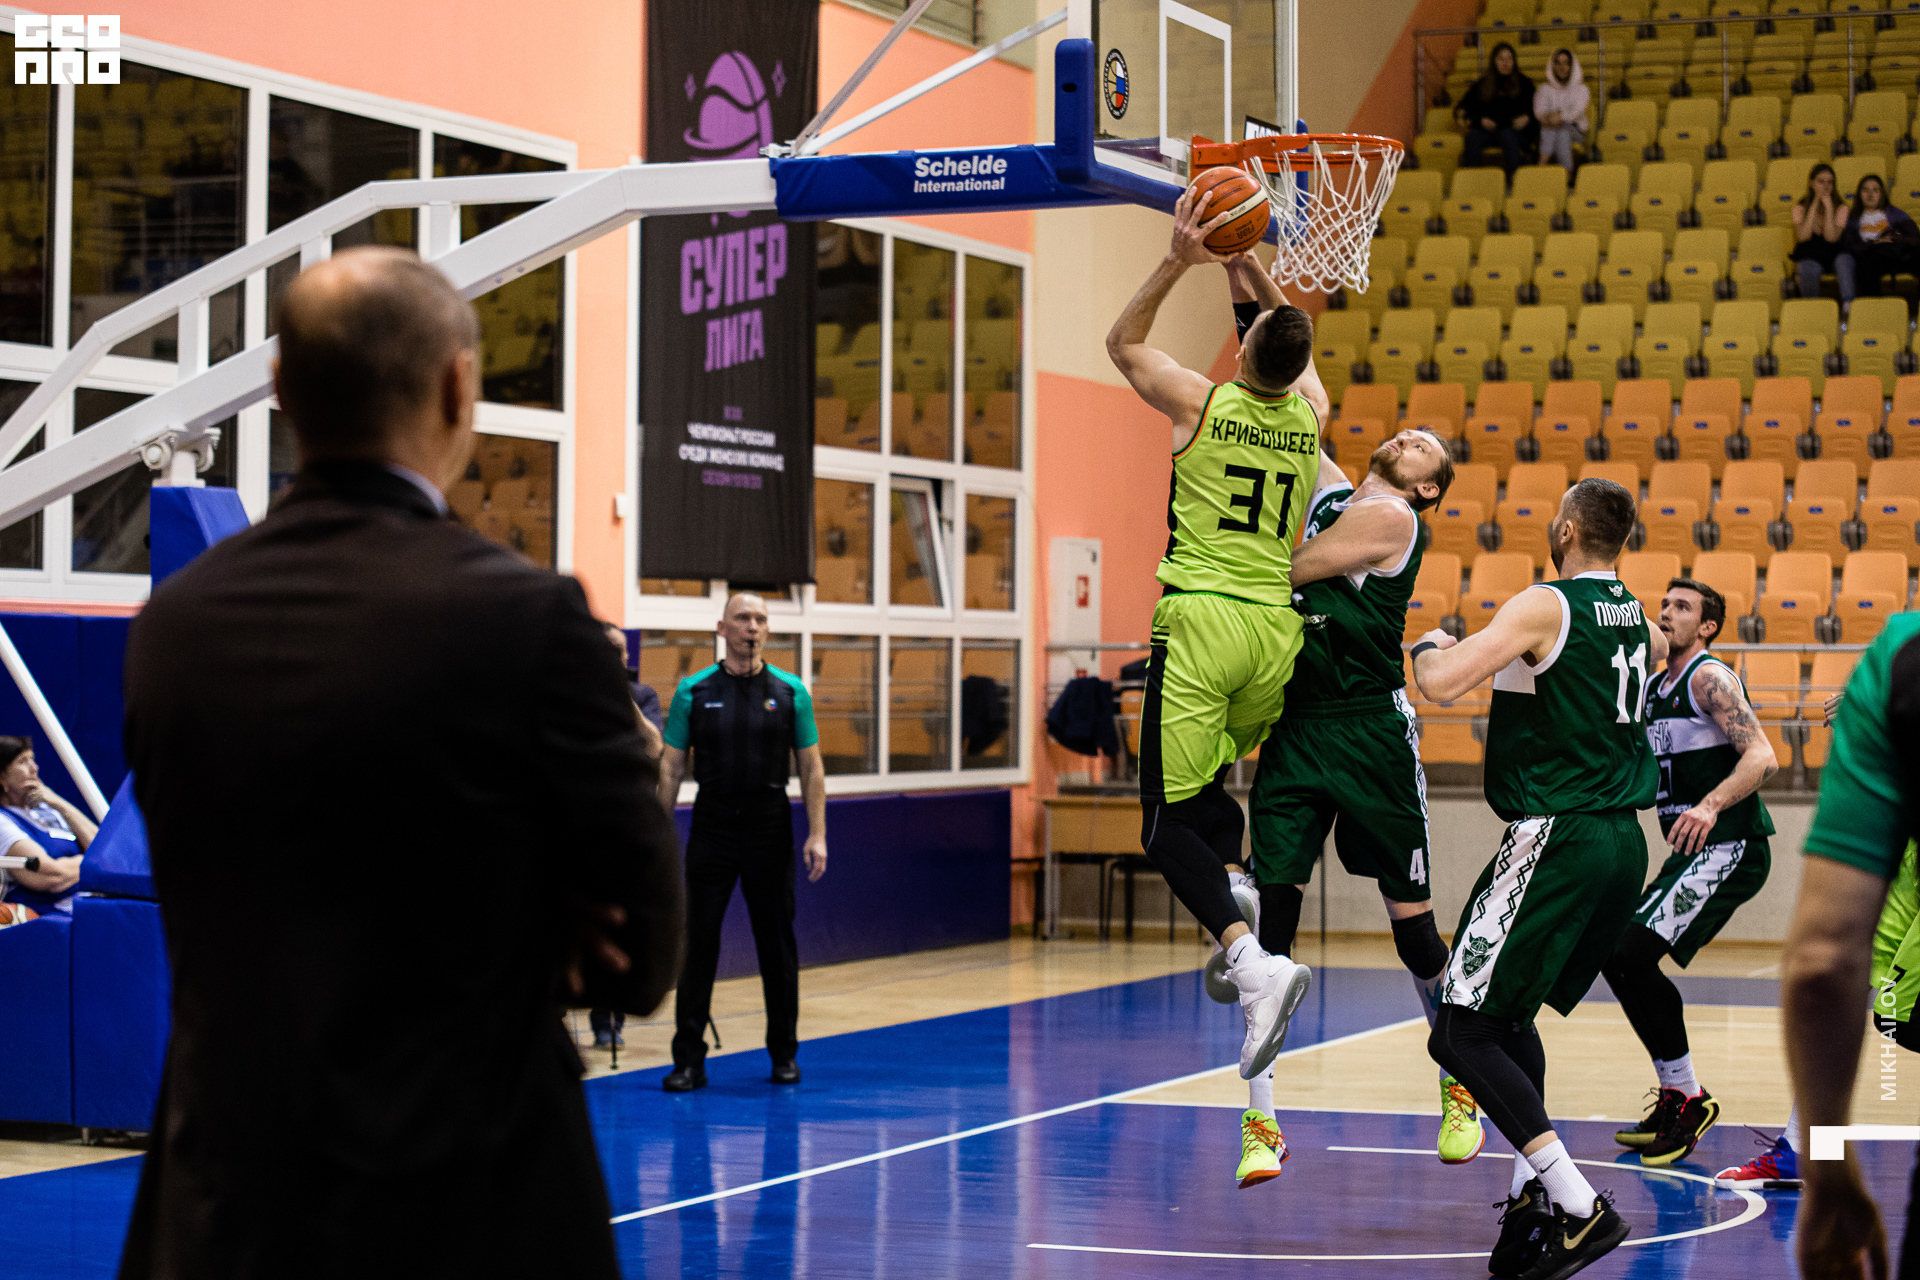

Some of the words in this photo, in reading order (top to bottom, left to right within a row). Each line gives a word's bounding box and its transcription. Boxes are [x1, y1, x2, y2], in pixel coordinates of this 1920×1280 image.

[913, 176, 1006, 193] International
[914, 154, 1008, 178] Schelde
[680, 222, 789, 316] СУПЕР
[703, 308, 766, 373] ЛИГА
[1211, 417, 1316, 456] КРИВОШЕЕВ
[1217, 463, 1299, 541] 31
[1611, 642, 1647, 724] 11
[1410, 847, 1427, 886] 4
